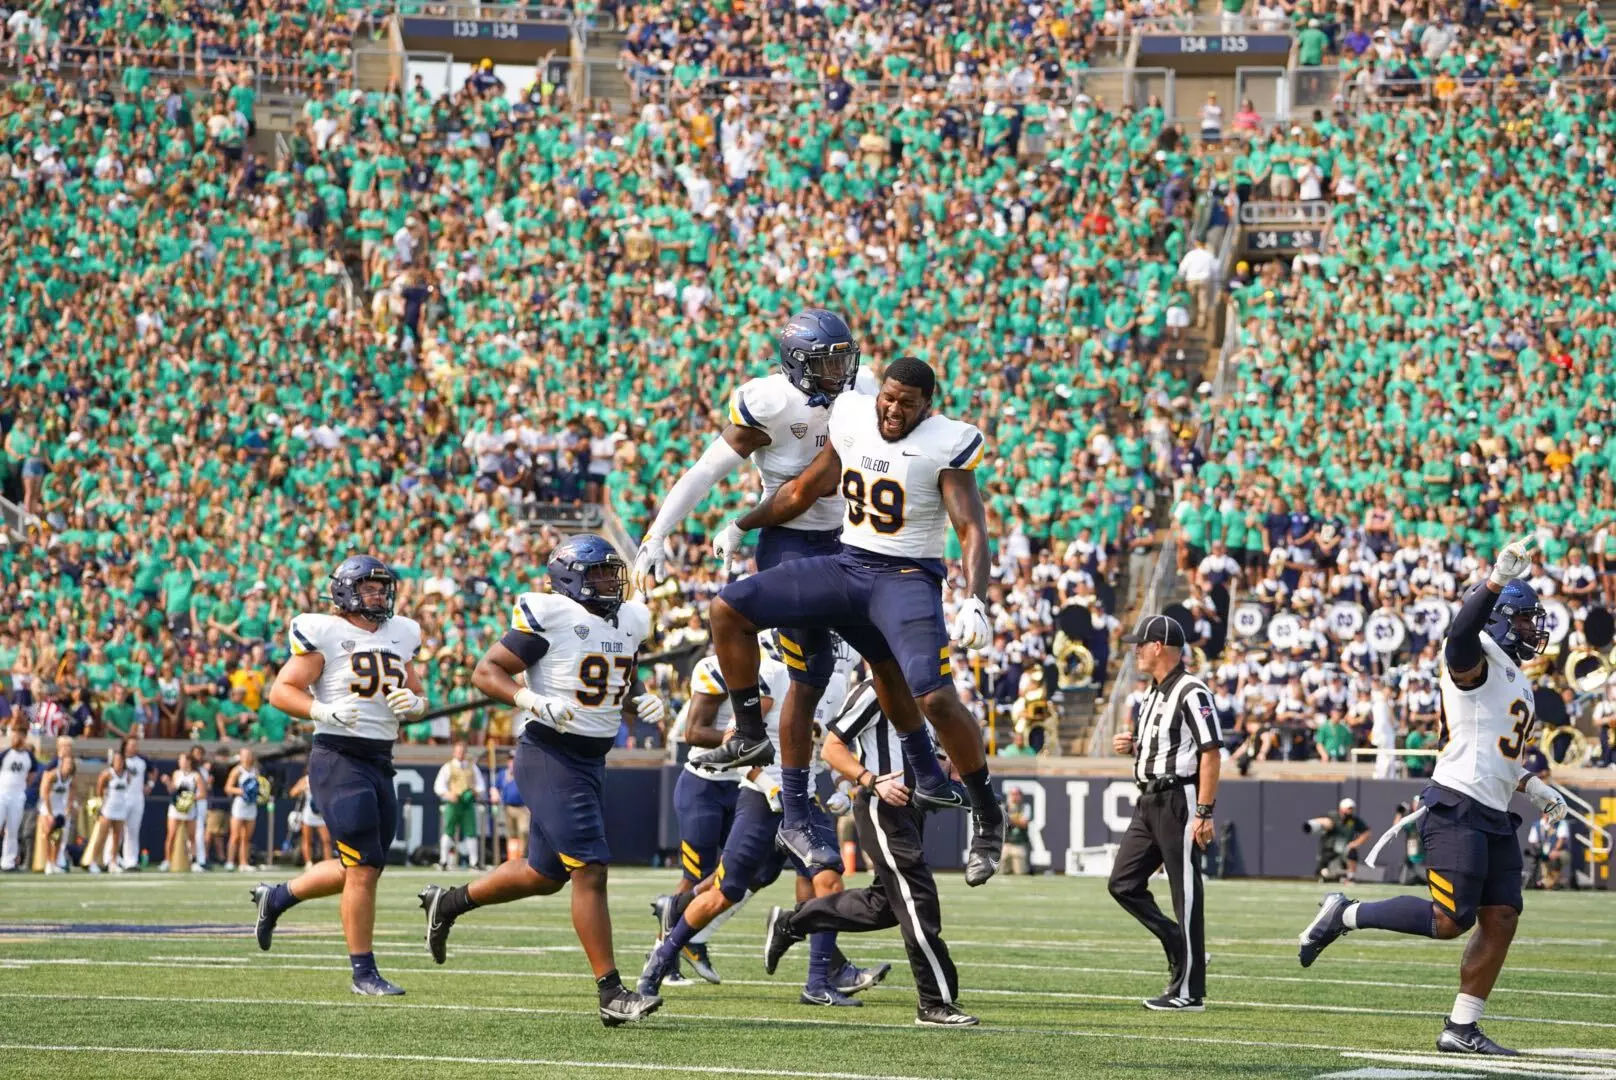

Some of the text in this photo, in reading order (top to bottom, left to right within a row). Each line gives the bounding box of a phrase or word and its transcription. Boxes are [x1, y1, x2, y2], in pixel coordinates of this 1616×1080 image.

[453, 22, 519, 38] 133 134
[1180, 36, 1249, 52] 134 135
[1256, 231, 1278, 249] 34
[860, 455, 890, 474] TOLEDO
[601, 641, 623, 653] TOLEDO
[350, 651, 407, 699] 95
[576, 653, 634, 708] 97
